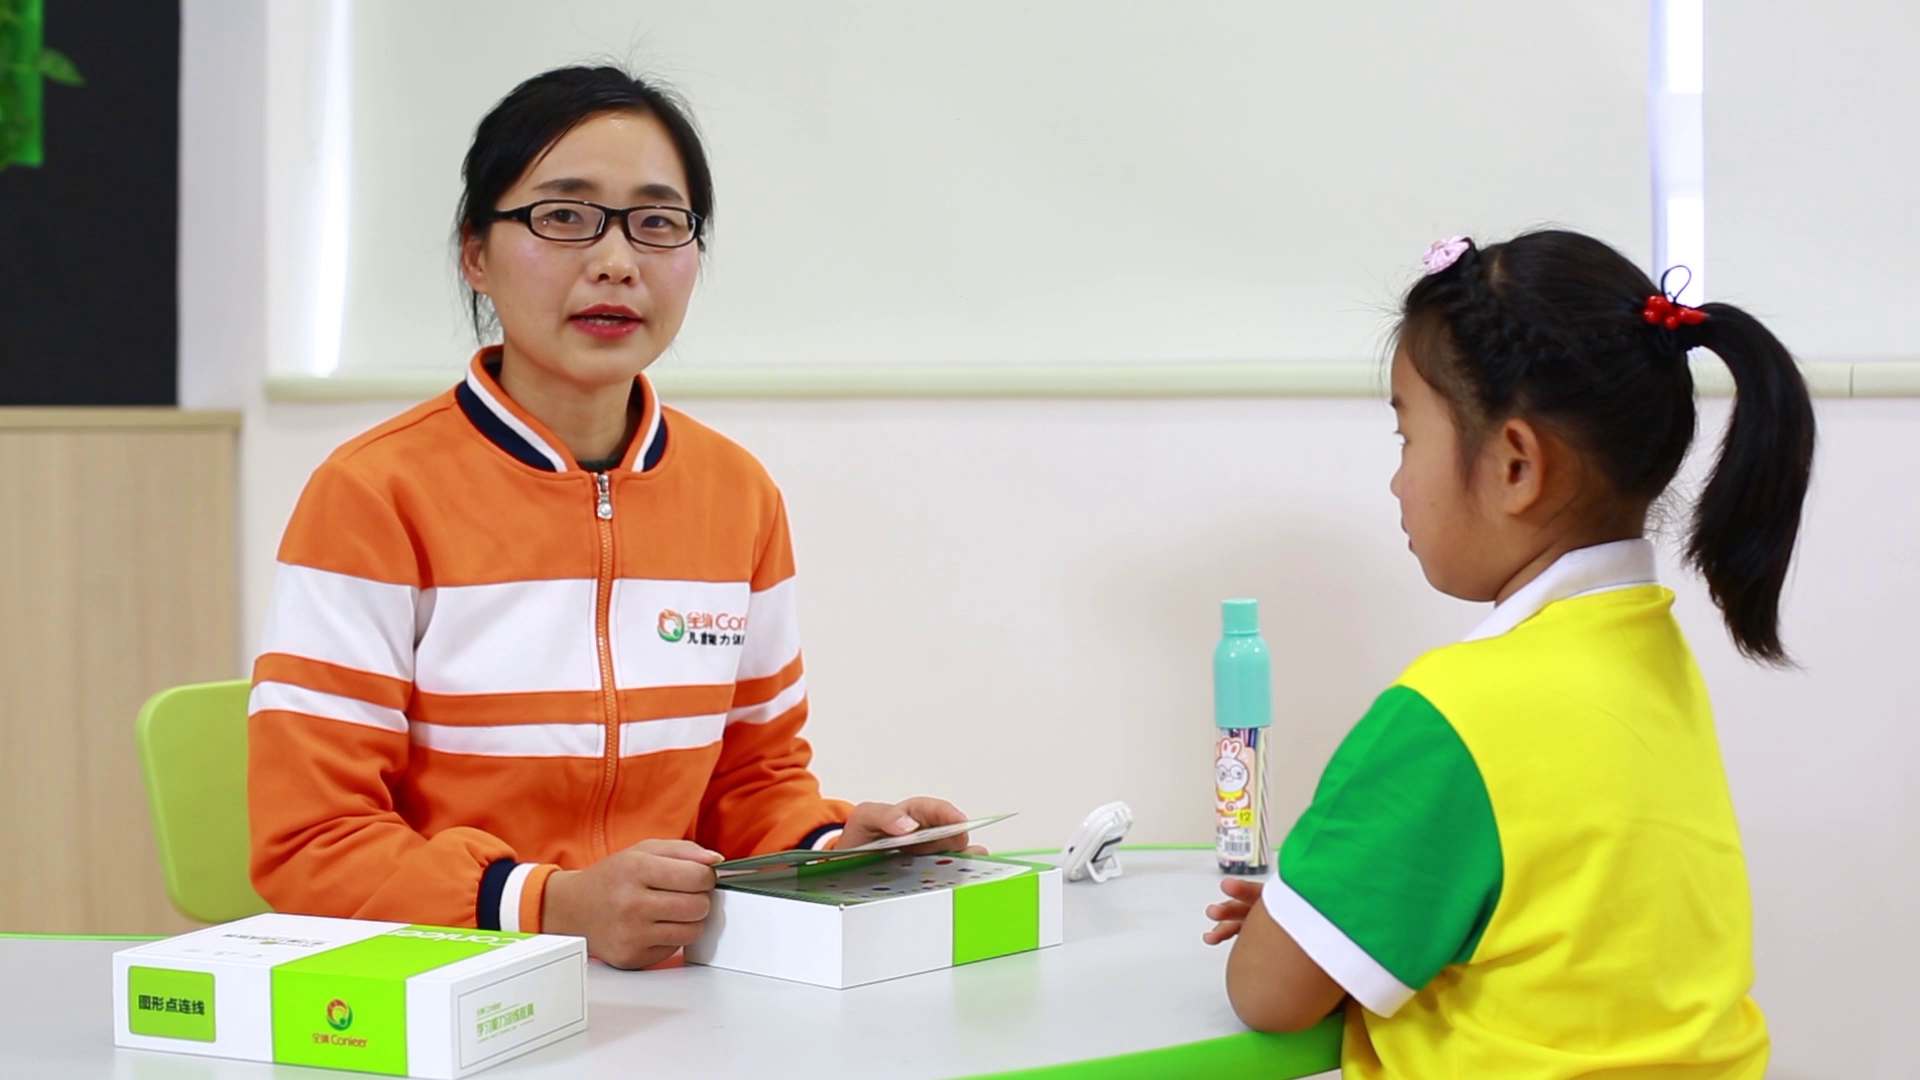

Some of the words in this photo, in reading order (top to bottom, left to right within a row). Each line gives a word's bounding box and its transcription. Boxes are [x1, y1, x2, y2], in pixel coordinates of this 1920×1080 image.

[1239, 811, 1252, 822] 12
[138, 994, 205, 1016] 图形点连线
